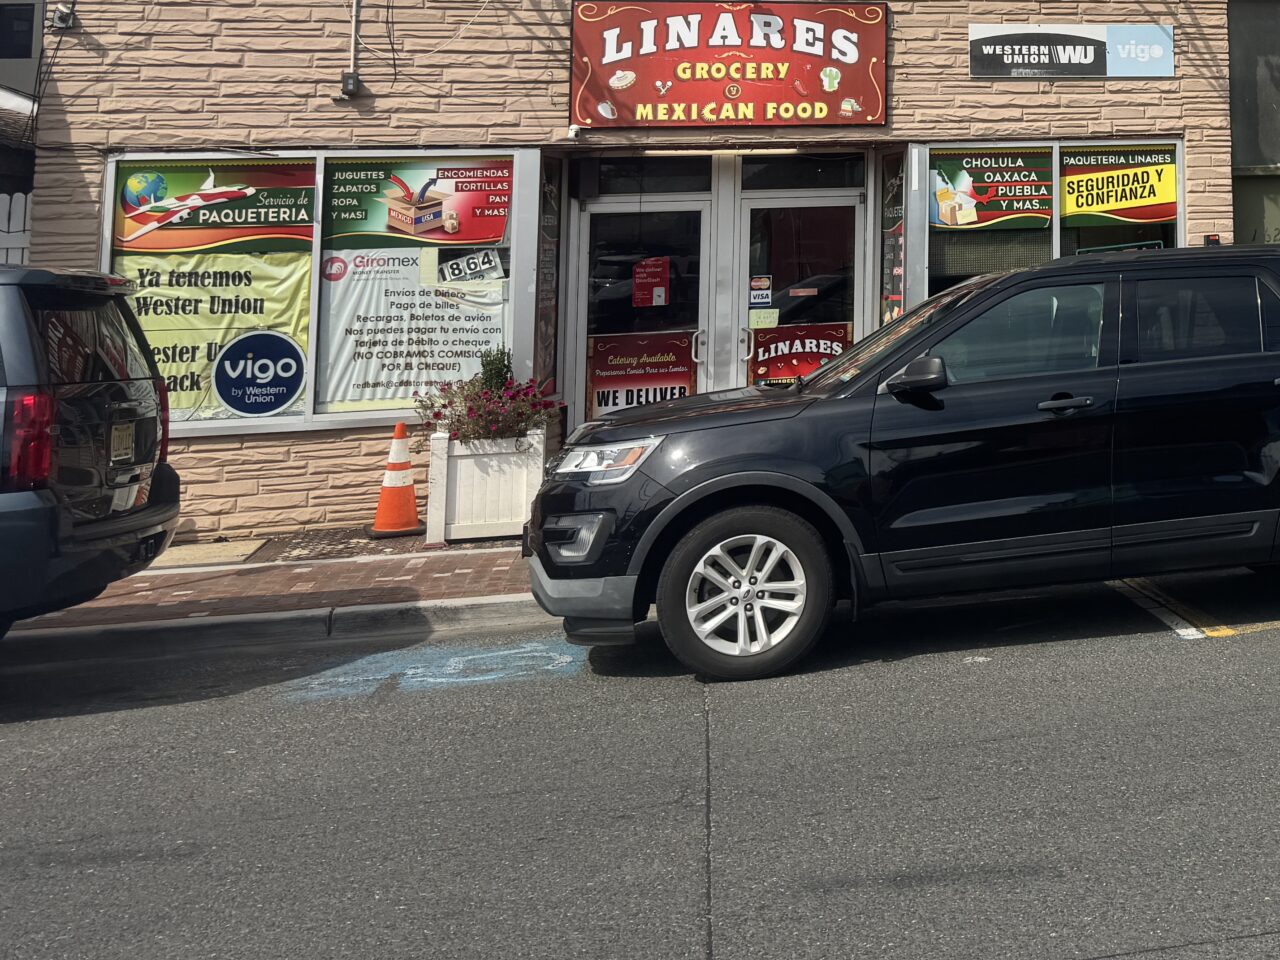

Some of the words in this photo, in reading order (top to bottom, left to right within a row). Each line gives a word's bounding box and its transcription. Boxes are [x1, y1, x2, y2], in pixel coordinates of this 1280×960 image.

[602, 12, 860, 65] LINARES
[982, 45, 1049, 54] WESTERN
[1057, 45, 1095, 64] WU
[1116, 40, 1164, 62] vigo
[1003, 54, 1049, 63] UNION
[677, 62, 790, 80] GROCERY
[635, 101, 754, 122] MEXICAN
[766, 102, 829, 119] FOOD
[962, 158, 1024, 168] CHOLULA
[1063, 156, 1126, 166] PAQUETERIA
[1129, 154, 1171, 164] LINARES
[333, 171, 385, 179] JUGUETES
[438, 169, 509, 178] ENCOMIENDAS
[984, 171, 1038, 182] OAXACA
[1066, 171, 1152, 195] SEGURIDAD
[1156, 168, 1164, 182] Y
[333, 184, 377, 193] ZAPATOS
[998, 186, 1048, 196] PUEBLA
[257, 191, 294, 206] Servicio
[297, 190, 308, 204] de
[332, 198, 359, 206] ROPA
[1075, 186, 1156, 208] CONFIANZA
[1000, 200, 1008, 210] Y
[199, 208, 309, 223] PAQUETERIA
[341, 211, 366, 219] MAS!
[390, 210, 412, 224] MEXICO
[485, 208, 508, 216] MAS!
[421, 214, 434, 223] USA
[353, 254, 419, 268] Giromex
[137, 268, 161, 288] Ya
[168, 268, 252, 288] tenemos
[384, 289, 416, 297] Envíos
[419, 289, 432, 297] de
[434, 289, 466, 299] Dinero
[135, 296, 203, 316] Wester
[209, 295, 265, 315] Union
[390, 301, 416, 311] Pago
[419, 301, 432, 309] de
[435, 301, 460, 310] billes
[410, 313, 445, 322] Boletos
[448, 313, 461, 321] de
[464, 313, 492, 322] avión
[345, 327, 363, 336] Nos
[367, 326, 404, 336] puedes
[407, 327, 437, 335] pagar
[452, 325, 480, 334] envío
[354, 340, 388, 348] Tarjeta
[391, 339, 404, 347] de
[407, 337, 440, 346] Débito
[452, 338, 491, 348] cheque
[150, 343, 200, 364] ester
[758, 339, 843, 361] LINARES
[353, 351, 373, 362] (NO
[376, 350, 435, 359] COBRAMOS
[608, 355, 638, 366] Catering
[640, 352, 677, 363] Available
[224, 352, 297, 383] vigo
[381, 363, 401, 371] POR
[417, 362, 461, 372] CHEQUE)
[160, 372, 202, 393] ack
[232, 387, 243, 397] by
[245, 386, 286, 395] Western
[597, 390, 619, 407] WE
[625, 386, 687, 406] DELIVER
[245, 394, 275, 403] Union
